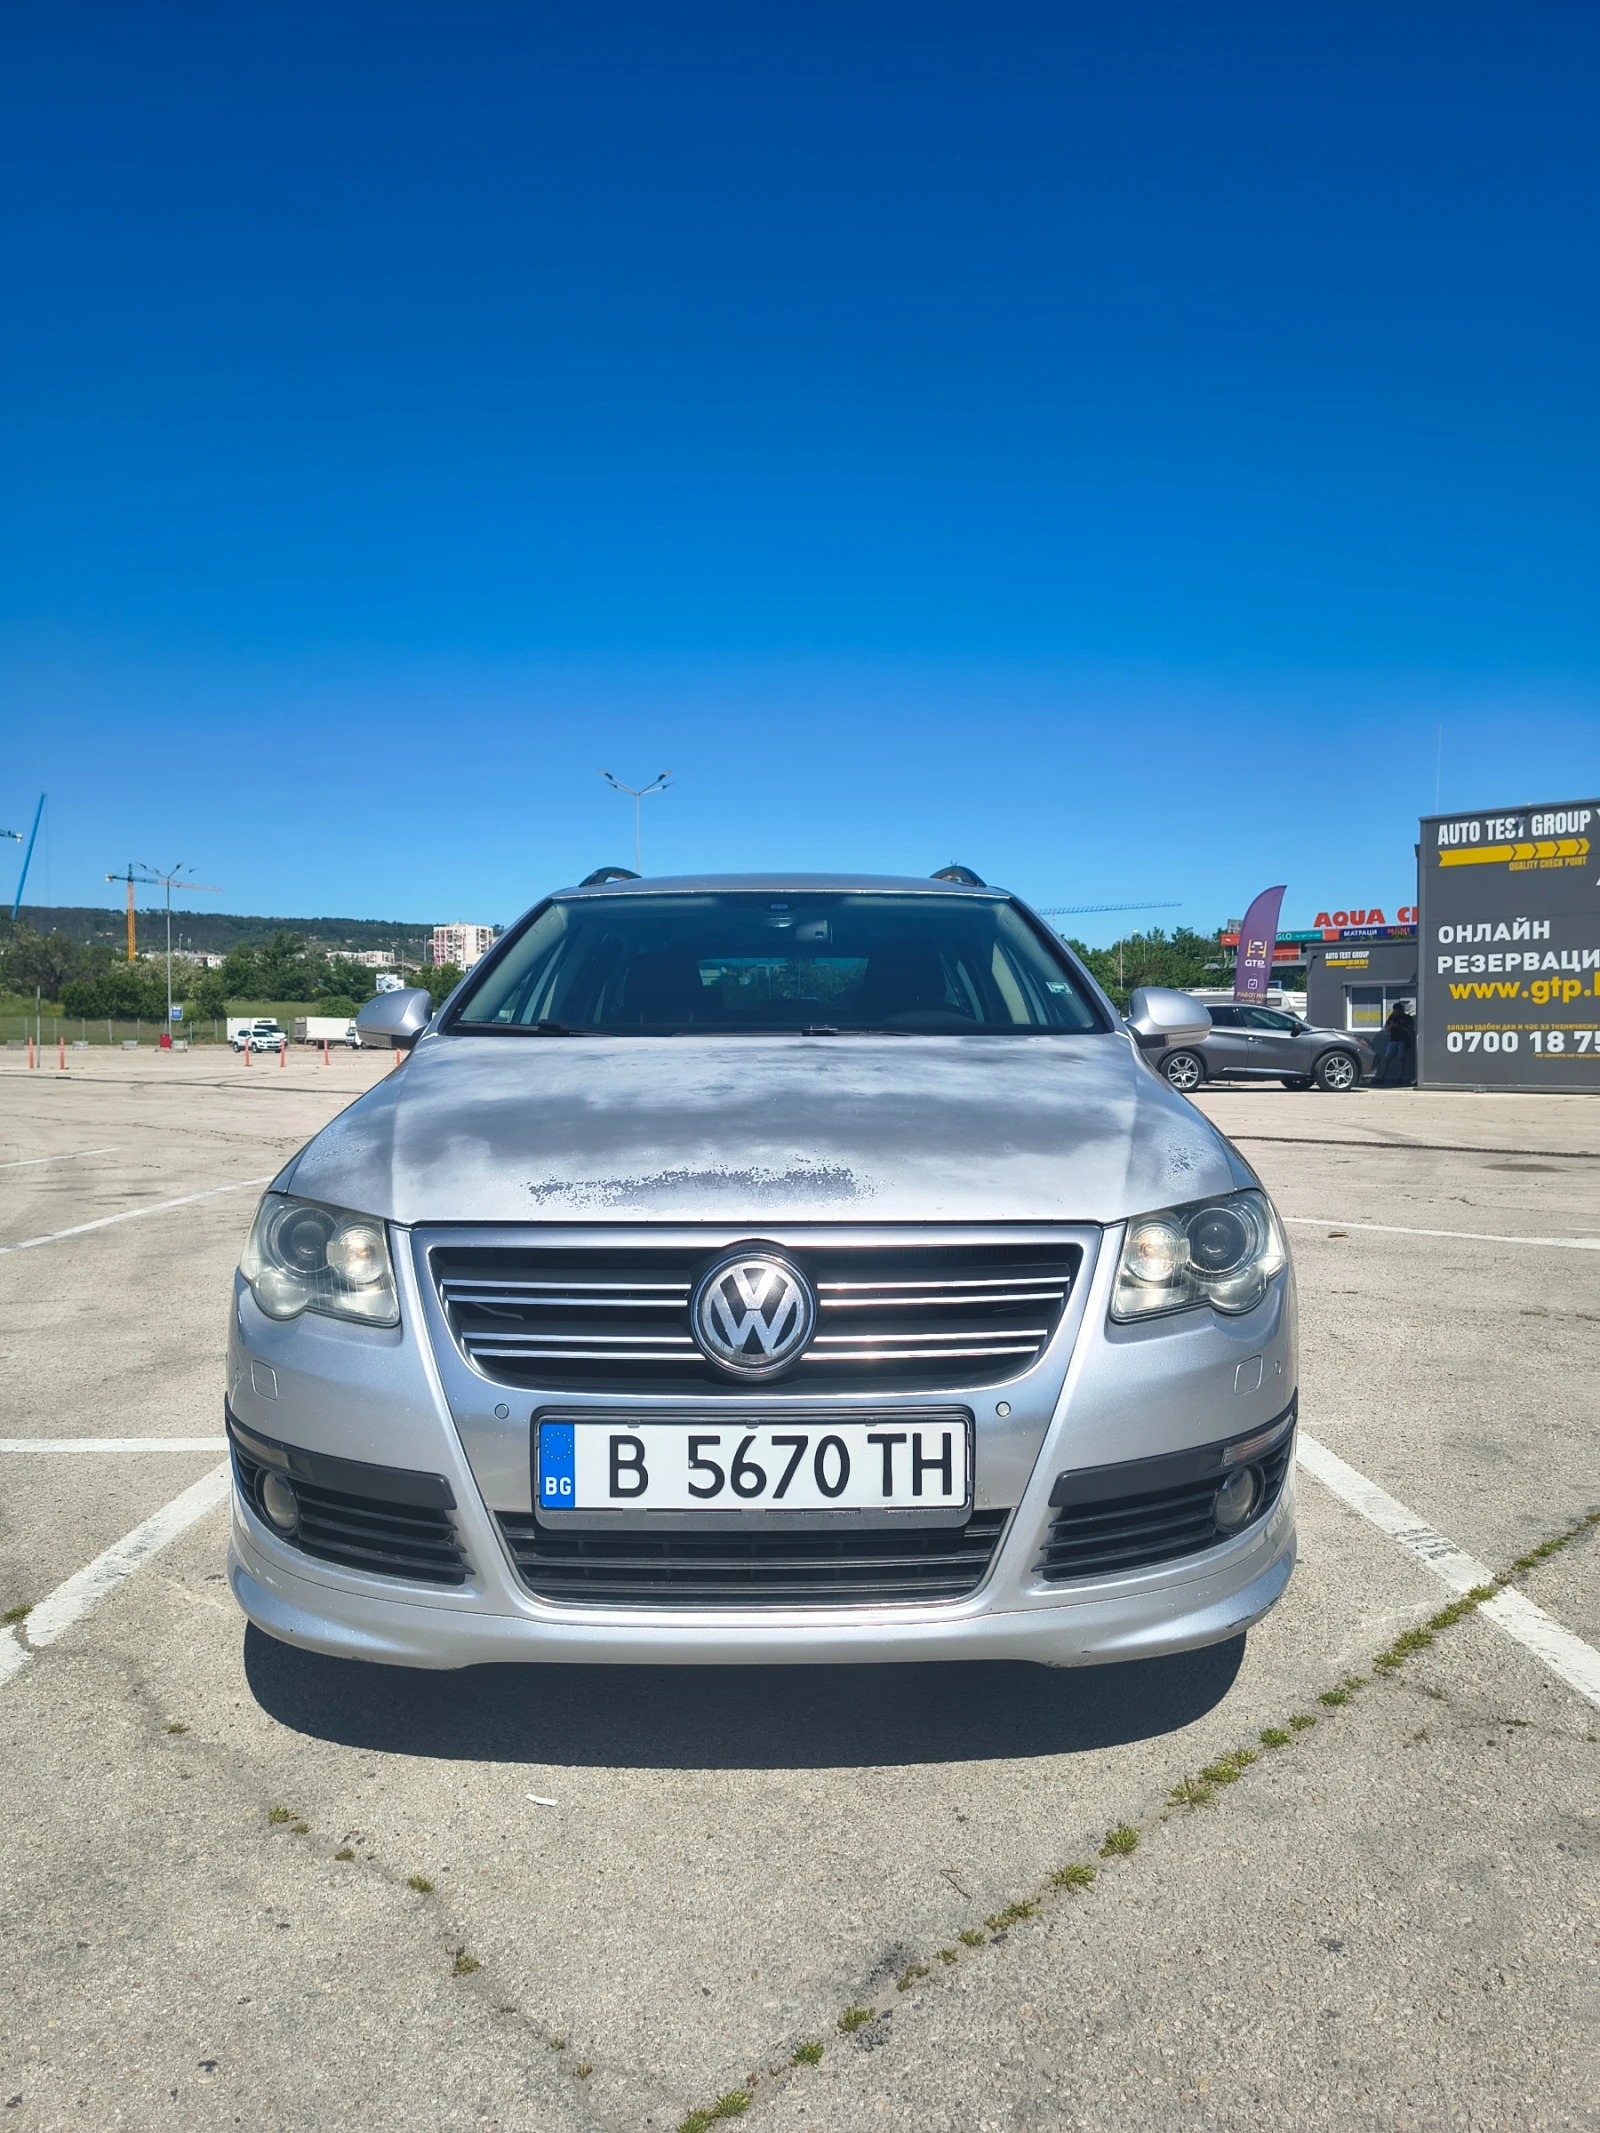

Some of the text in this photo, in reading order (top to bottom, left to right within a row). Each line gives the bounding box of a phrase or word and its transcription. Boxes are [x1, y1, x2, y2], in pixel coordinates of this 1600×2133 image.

[1438, 810, 1591, 845] AUTO TEST GROUP
[1509, 856, 1587, 871] QUALITY CHECK POINT
[1313, 909, 1386, 928] AQUA
[1343, 929, 1377, 937] МАТРАЦИ
[1438, 917, 1550, 944] ОНЛАЙН
[1325, 951, 1369, 960] AUTO TEST GROUP
[1437, 949, 1600, 974] РЕЗЕРВАЦИ
[1474, 1021, 1500, 1031] удобен
[1446, 1031, 1518, 1053] 0700
[1529, 1031, 1565, 1053] 18
[609, 1432, 953, 1498] B 5670 TH
[545, 1476, 572, 1496] BG
